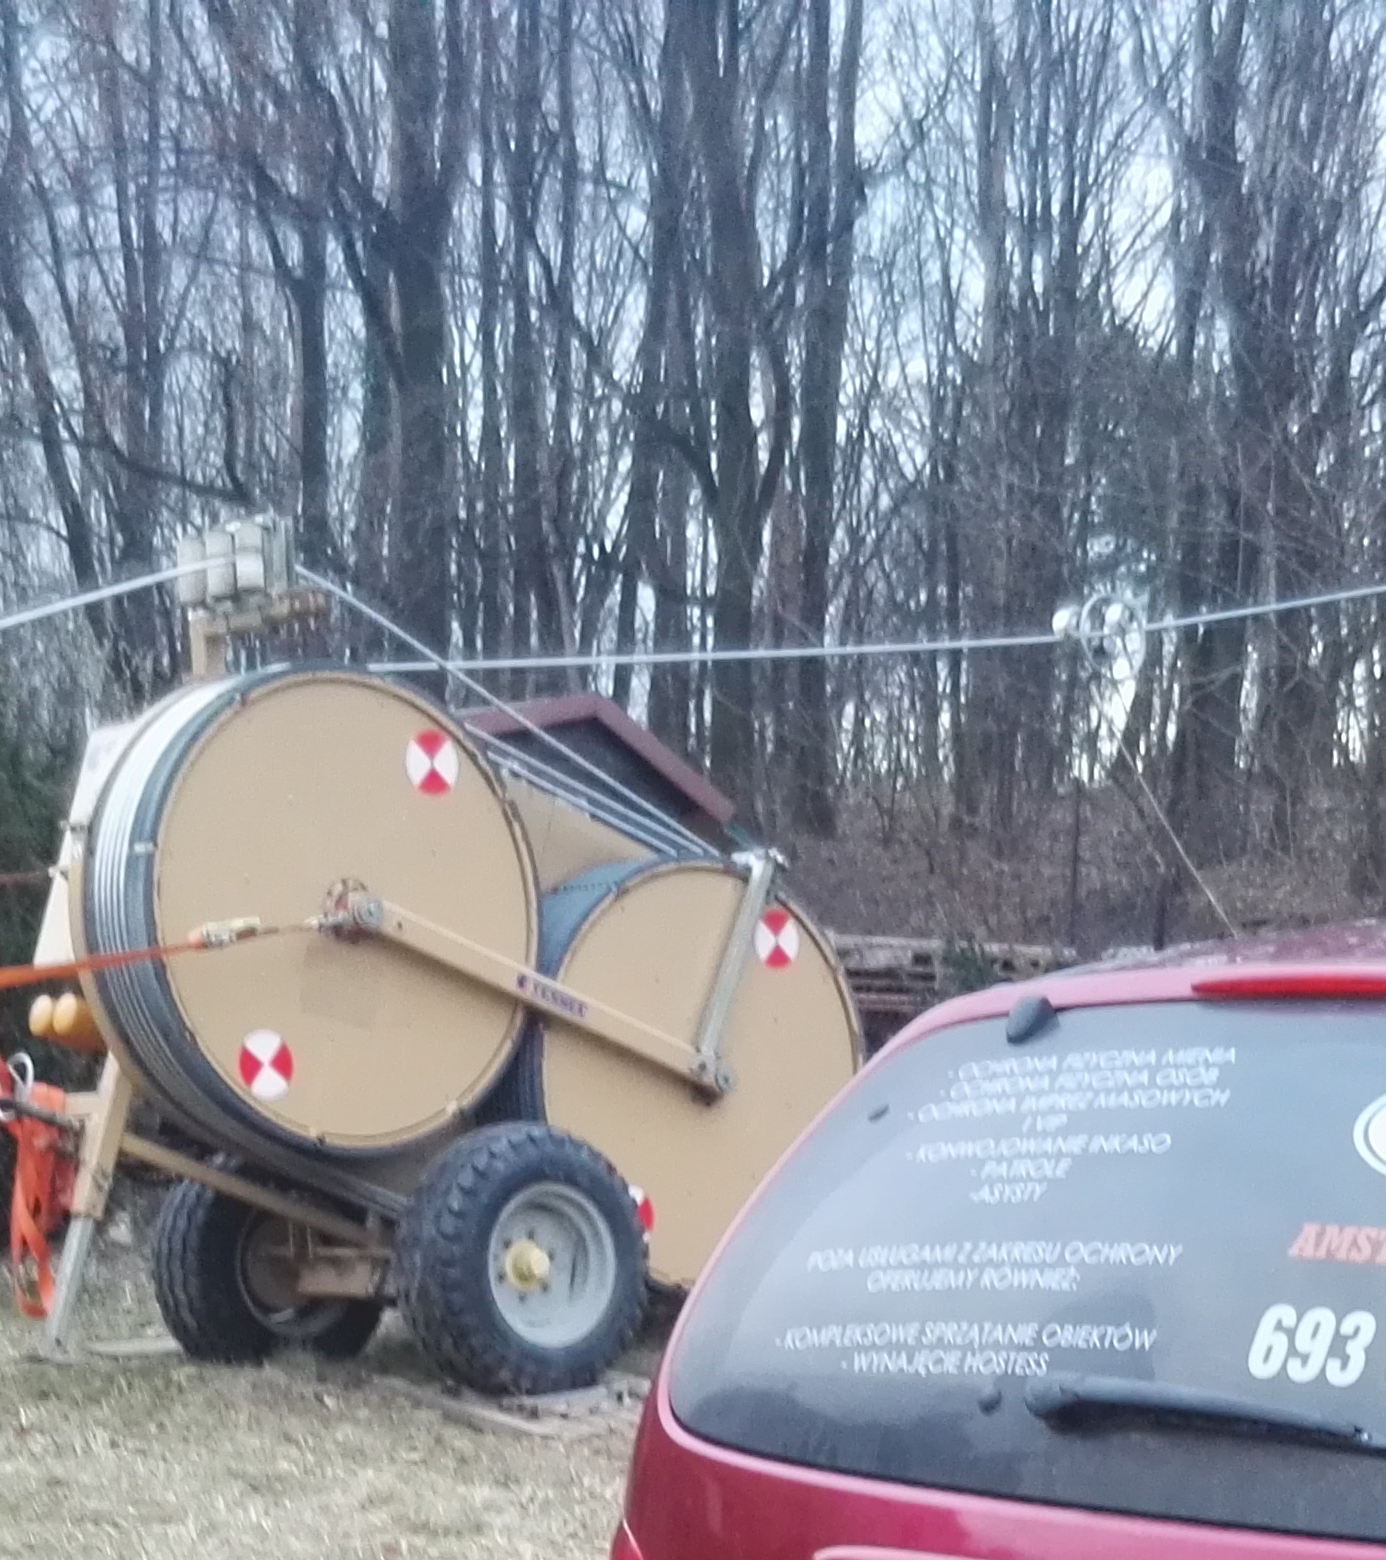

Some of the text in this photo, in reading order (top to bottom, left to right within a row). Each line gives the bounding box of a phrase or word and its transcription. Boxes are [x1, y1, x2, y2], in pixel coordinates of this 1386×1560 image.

[1064, 1241, 1183, 1267] OCHRONY
[1041, 1320, 1158, 1352] OBIEKTÓW
[1246, 1302, 1377, 1388] 693
[963, 1350, 1050, 1377] HOSTESS
